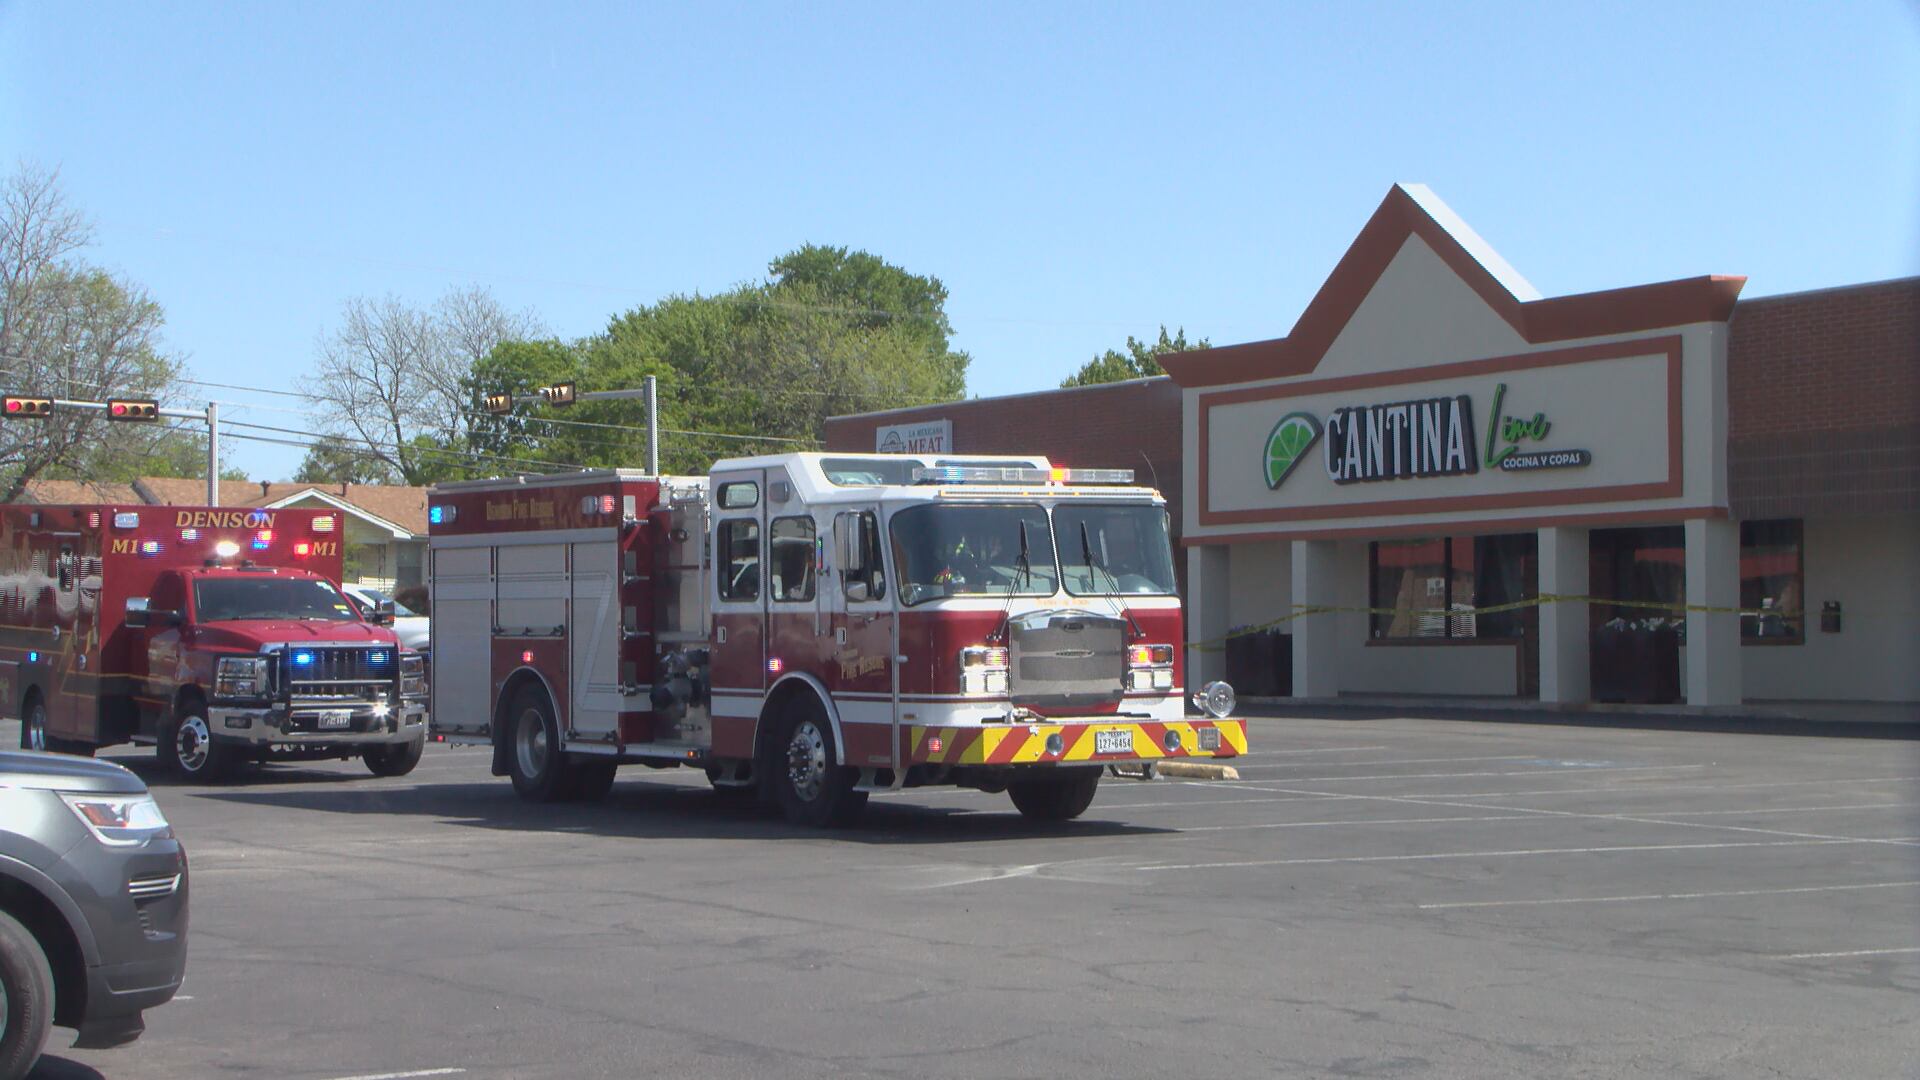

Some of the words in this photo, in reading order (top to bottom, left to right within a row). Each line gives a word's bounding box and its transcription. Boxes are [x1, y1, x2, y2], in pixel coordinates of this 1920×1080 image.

[1485, 384, 1550, 469] Lime
[908, 436, 944, 454] MEAT
[1324, 399, 1468, 481] CANTINA
[1503, 457, 1539, 468] COCINA
[1541, 456, 1548, 466] Y
[1549, 454, 1581, 466] COPAS
[176, 511, 277, 528] DENISON
[111, 539, 138, 554] M1
[312, 542, 337, 556] M1
